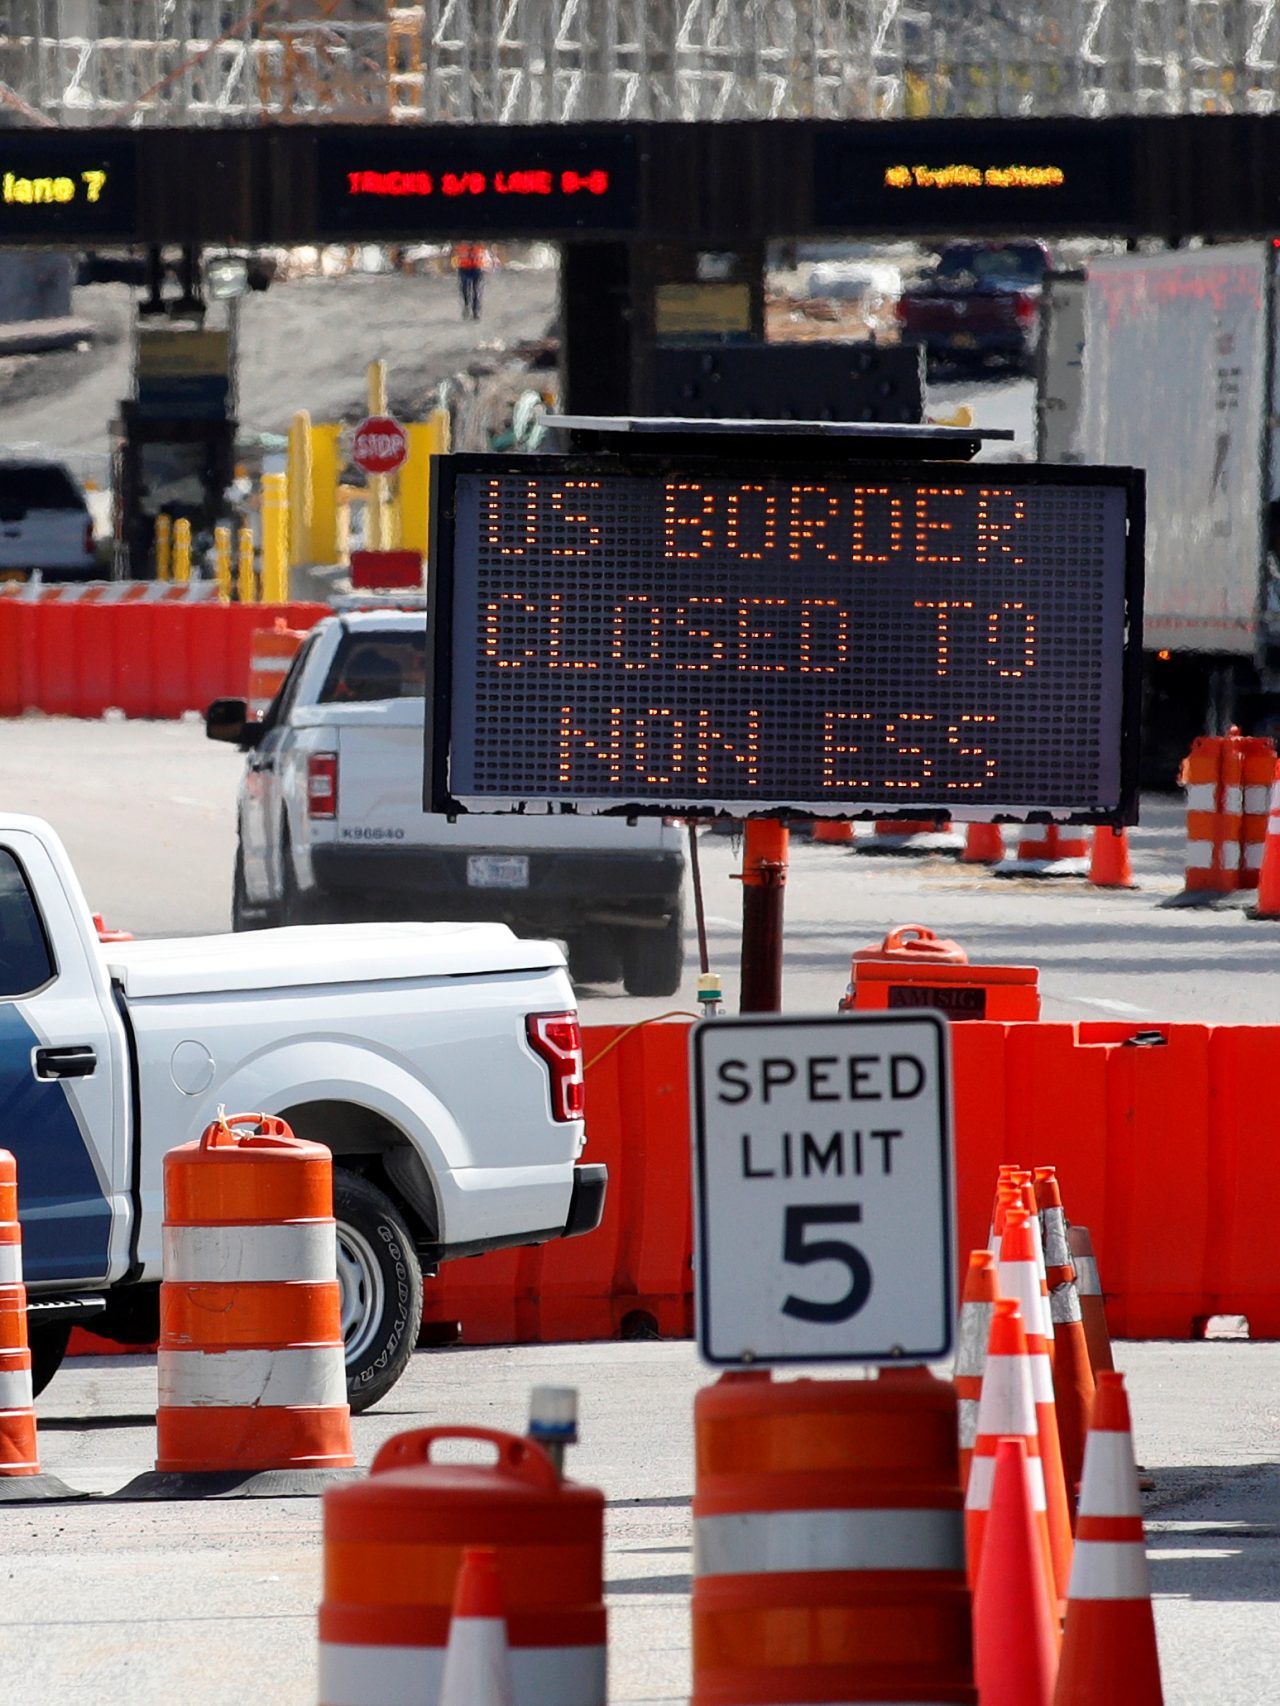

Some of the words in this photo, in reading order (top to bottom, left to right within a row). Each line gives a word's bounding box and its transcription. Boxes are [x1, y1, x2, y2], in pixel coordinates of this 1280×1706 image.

[81, 170, 106, 202] 7
[356, 434, 404, 459] STOP
[486, 479, 601, 555] US
[664, 483, 1024, 563] BORDER
[486, 593, 848, 673] CLOSED
[915, 600, 1037, 677] TO
[559, 706, 758, 785] NON
[824, 711, 997, 789] ESS
[718, 1053, 927, 1105] SPEED
[741, 1130, 903, 1178] LIMIT
[360, 1224, 409, 1383] GOODYEAR
[780, 1203, 873, 1324] 5
